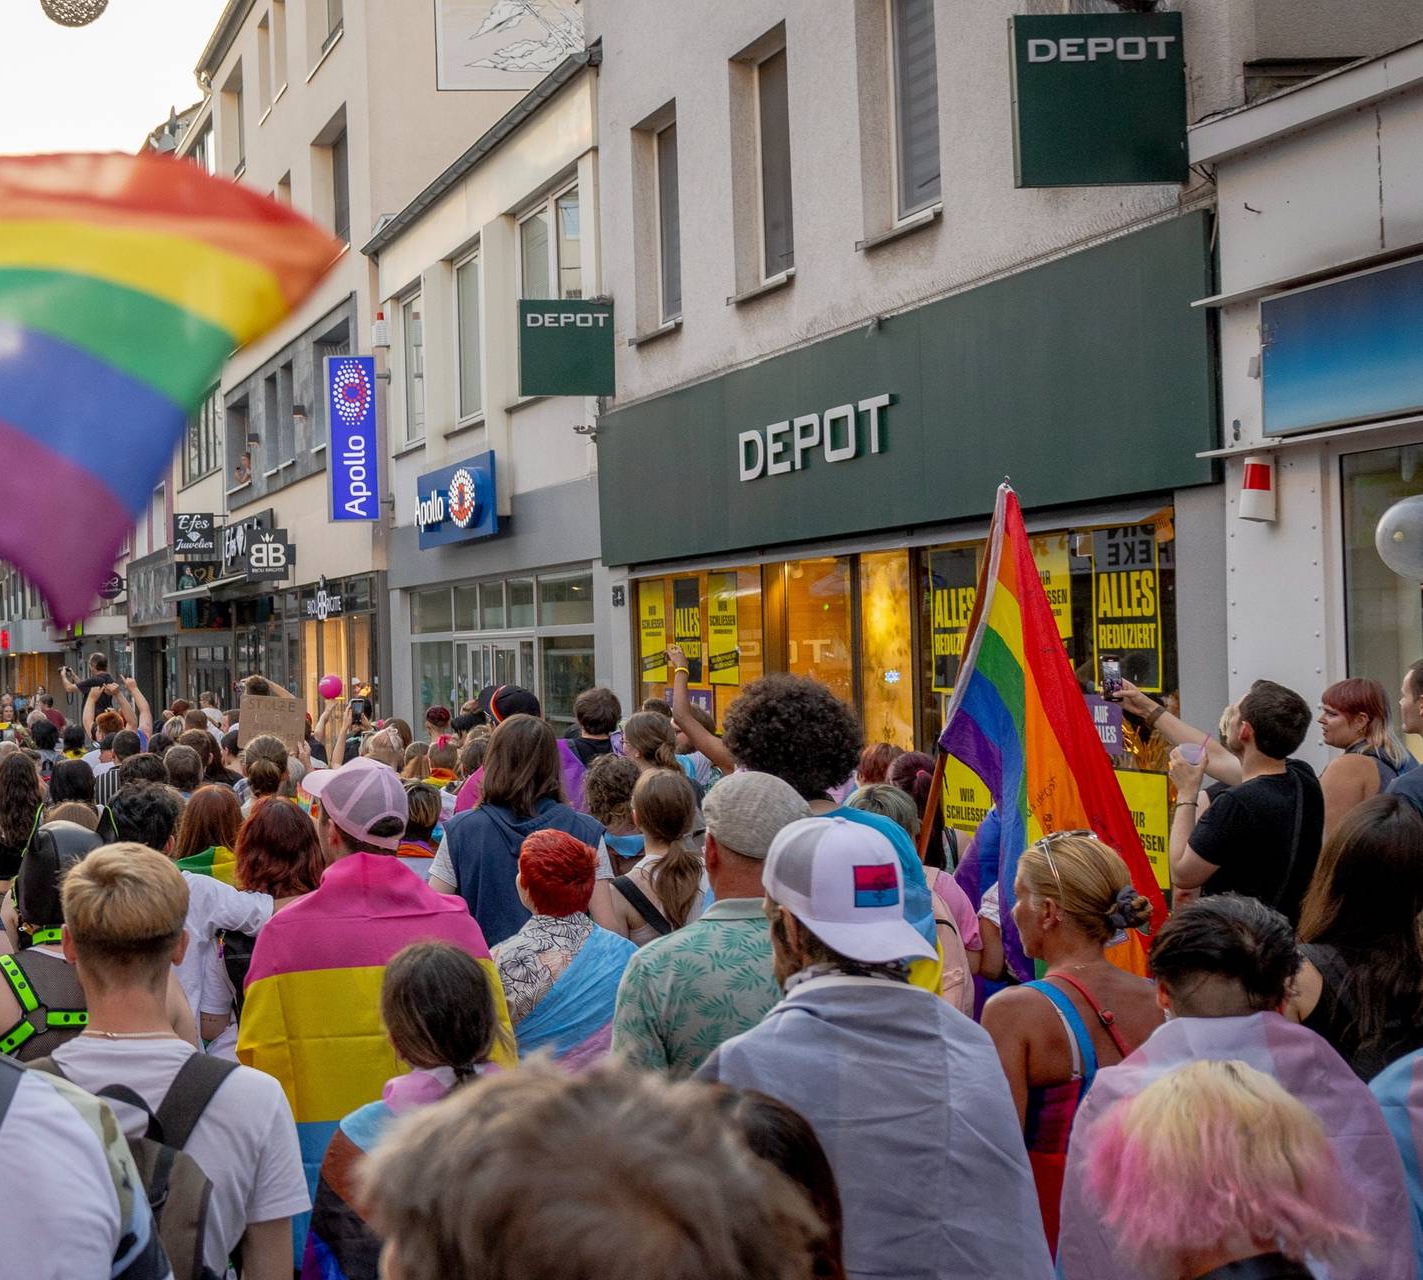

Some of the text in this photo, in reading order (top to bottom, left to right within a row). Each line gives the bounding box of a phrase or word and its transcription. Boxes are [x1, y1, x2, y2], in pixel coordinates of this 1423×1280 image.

[1028, 36, 1175, 62] DEPOT
[526, 313, 609, 327] DEPOT
[739, 393, 889, 481] DEPOT
[343, 435, 371, 516] Apollo
[177, 515, 209, 532] Efes
[414, 490, 444, 532] Apollo
[175, 538, 213, 551] Juwelier
[1098, 570, 1155, 617] ALLES
[935, 587, 976, 628] ALLES
[676, 607, 700, 637] ALLES
[1098, 623, 1156, 649] REDUZIERT
[1094, 705, 1109, 723] AUF
[959, 788, 975, 802] WIR
